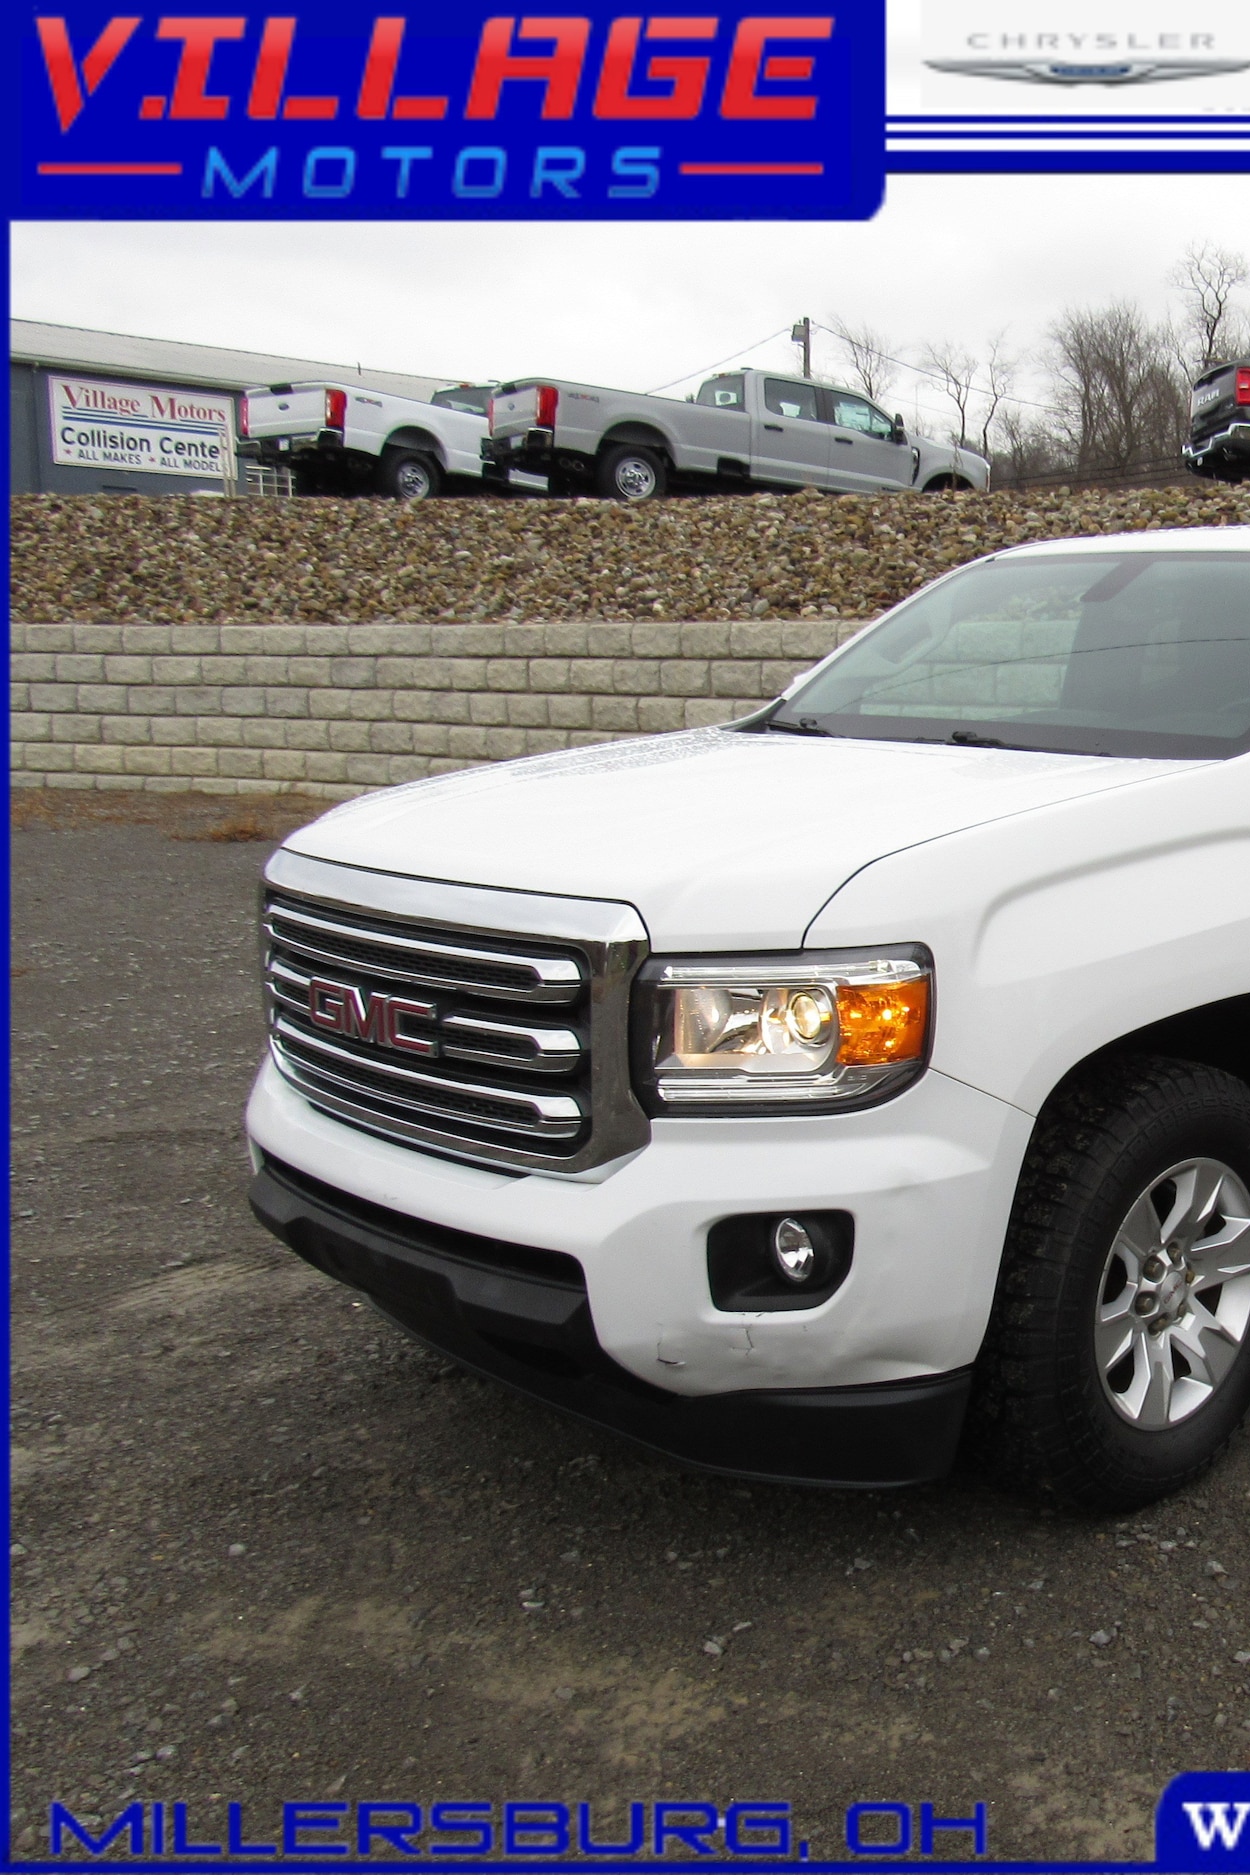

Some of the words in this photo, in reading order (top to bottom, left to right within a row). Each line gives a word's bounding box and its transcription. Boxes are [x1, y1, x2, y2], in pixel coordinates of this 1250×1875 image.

[60, 384, 141, 416] Village
[149, 395, 226, 423] Motors
[60, 427, 150, 452] Collision
[159, 436, 227, 460] Cente
[78, 448, 99, 461] ALL
[103, 452, 142, 465] MAKES
[160, 457, 180, 469] ALL
[309, 976, 439, 1058] GMC
